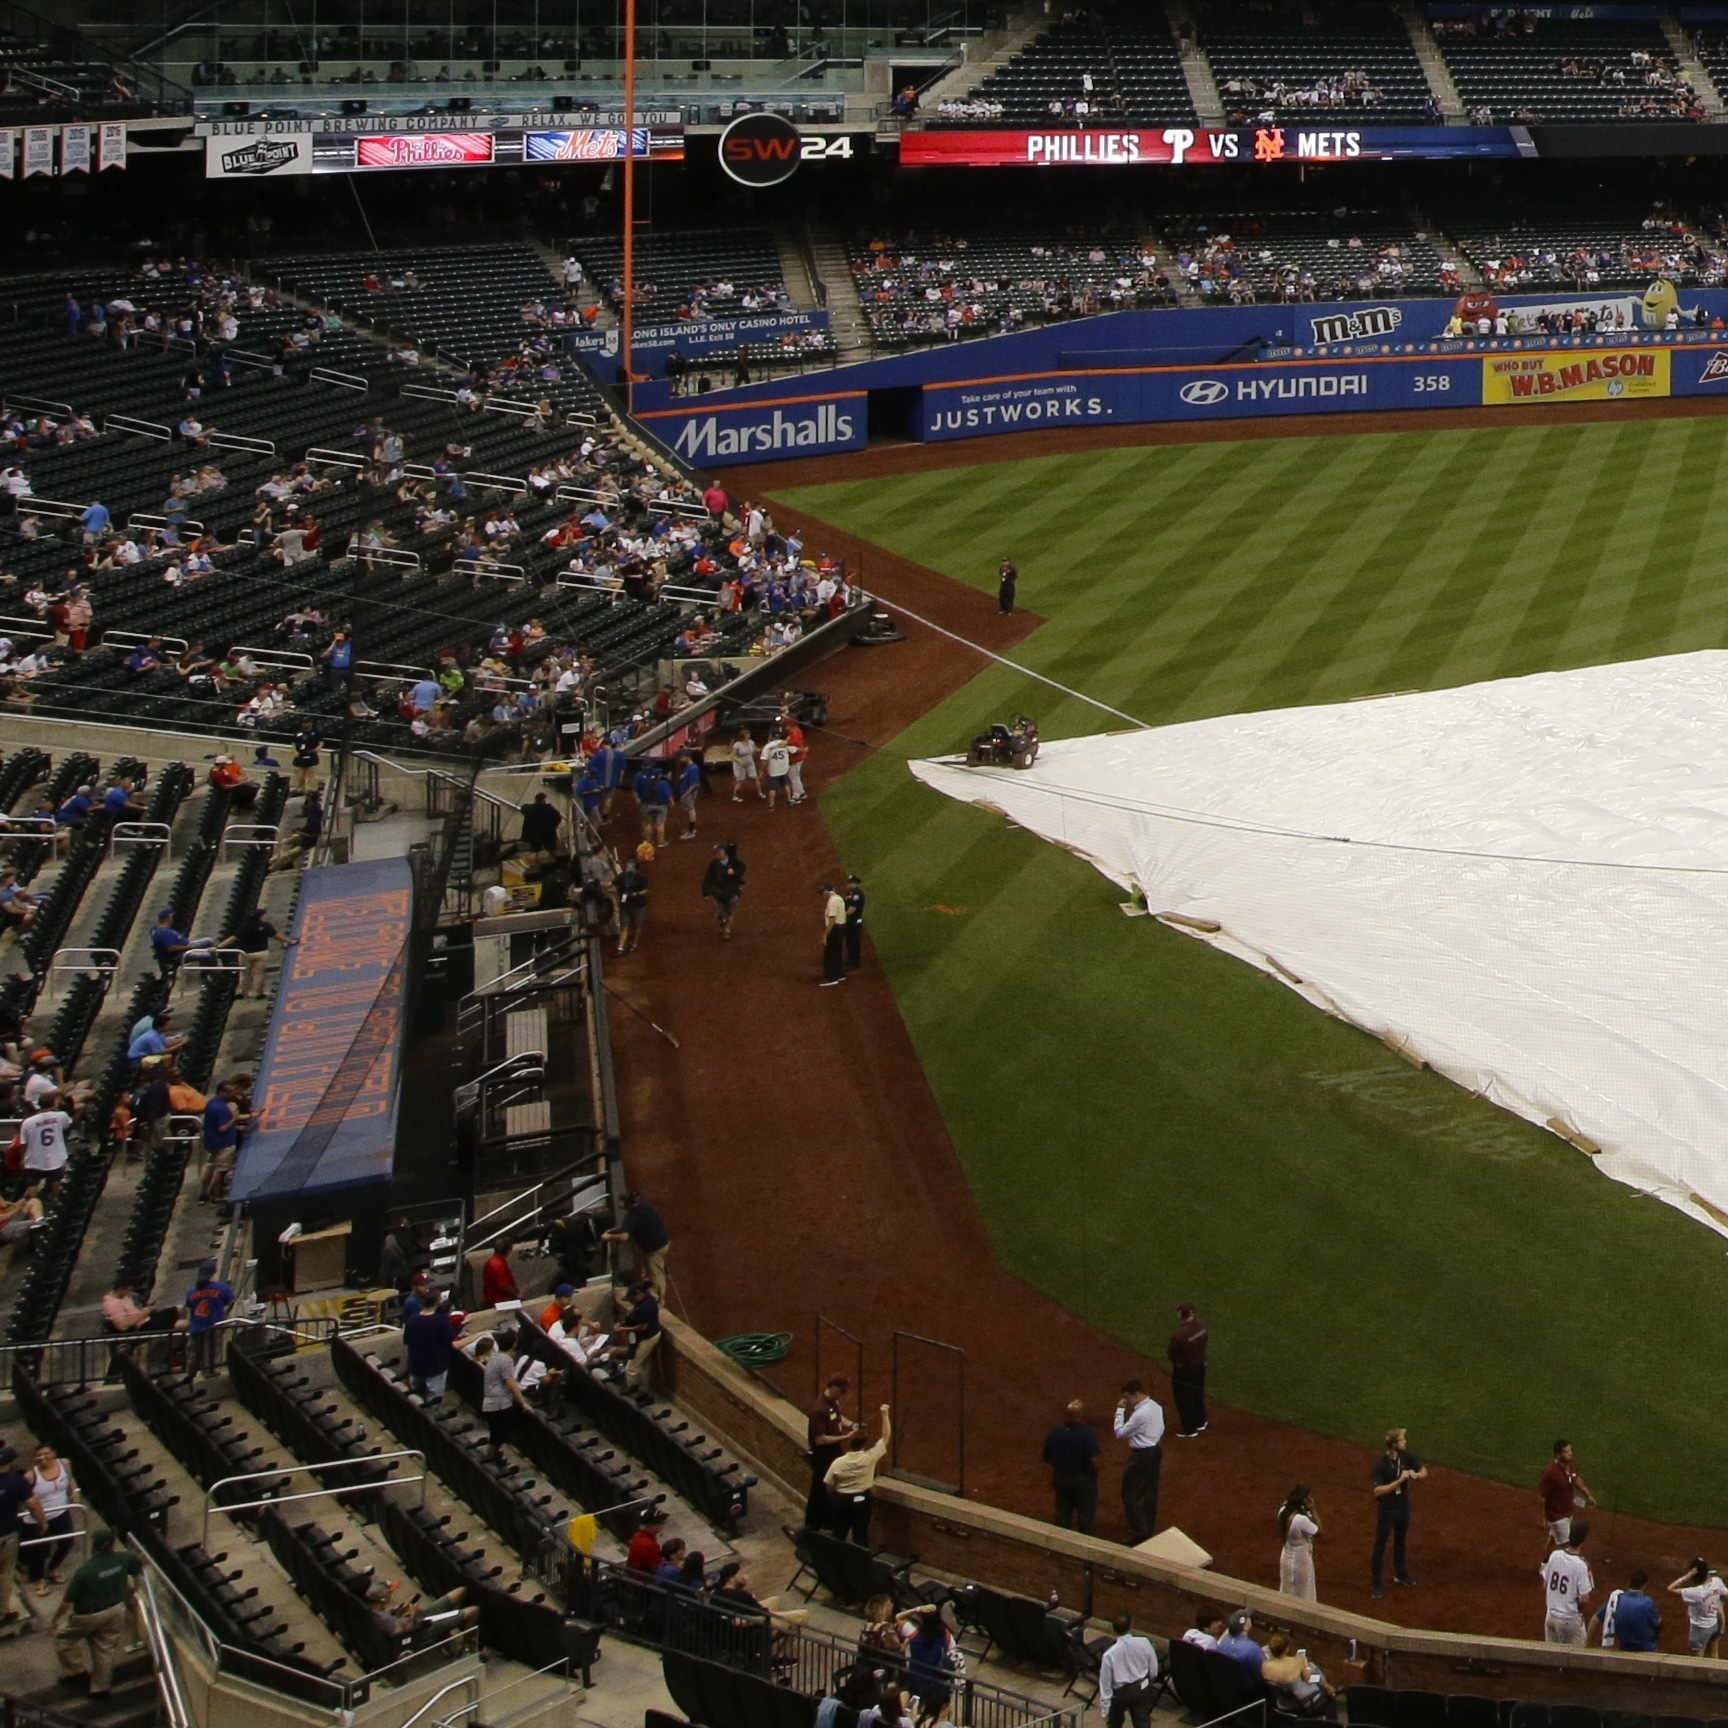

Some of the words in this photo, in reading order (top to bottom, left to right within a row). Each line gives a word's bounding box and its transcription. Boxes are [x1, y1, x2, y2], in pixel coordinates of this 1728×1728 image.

[212, 121, 254, 135] BLUE
[265, 120, 313, 134] POINT
[324, 117, 400, 131] BREWING
[406, 115, 480, 129] COMPANY
[1027, 134, 1139, 161] PHILLIES
[1209, 133, 1239, 158] VS
[1298, 131, 1360, 156] METS
[1237, 374, 1368, 401] HYUNDAI
[1414, 375, 1450, 393] 358
[930, 397, 1112, 431] JUSTWORKS.
[674, 403, 853, 458] Marshalls
[772, 750, 784, 761] 45
[1551, 1572, 1569, 1595] 86
